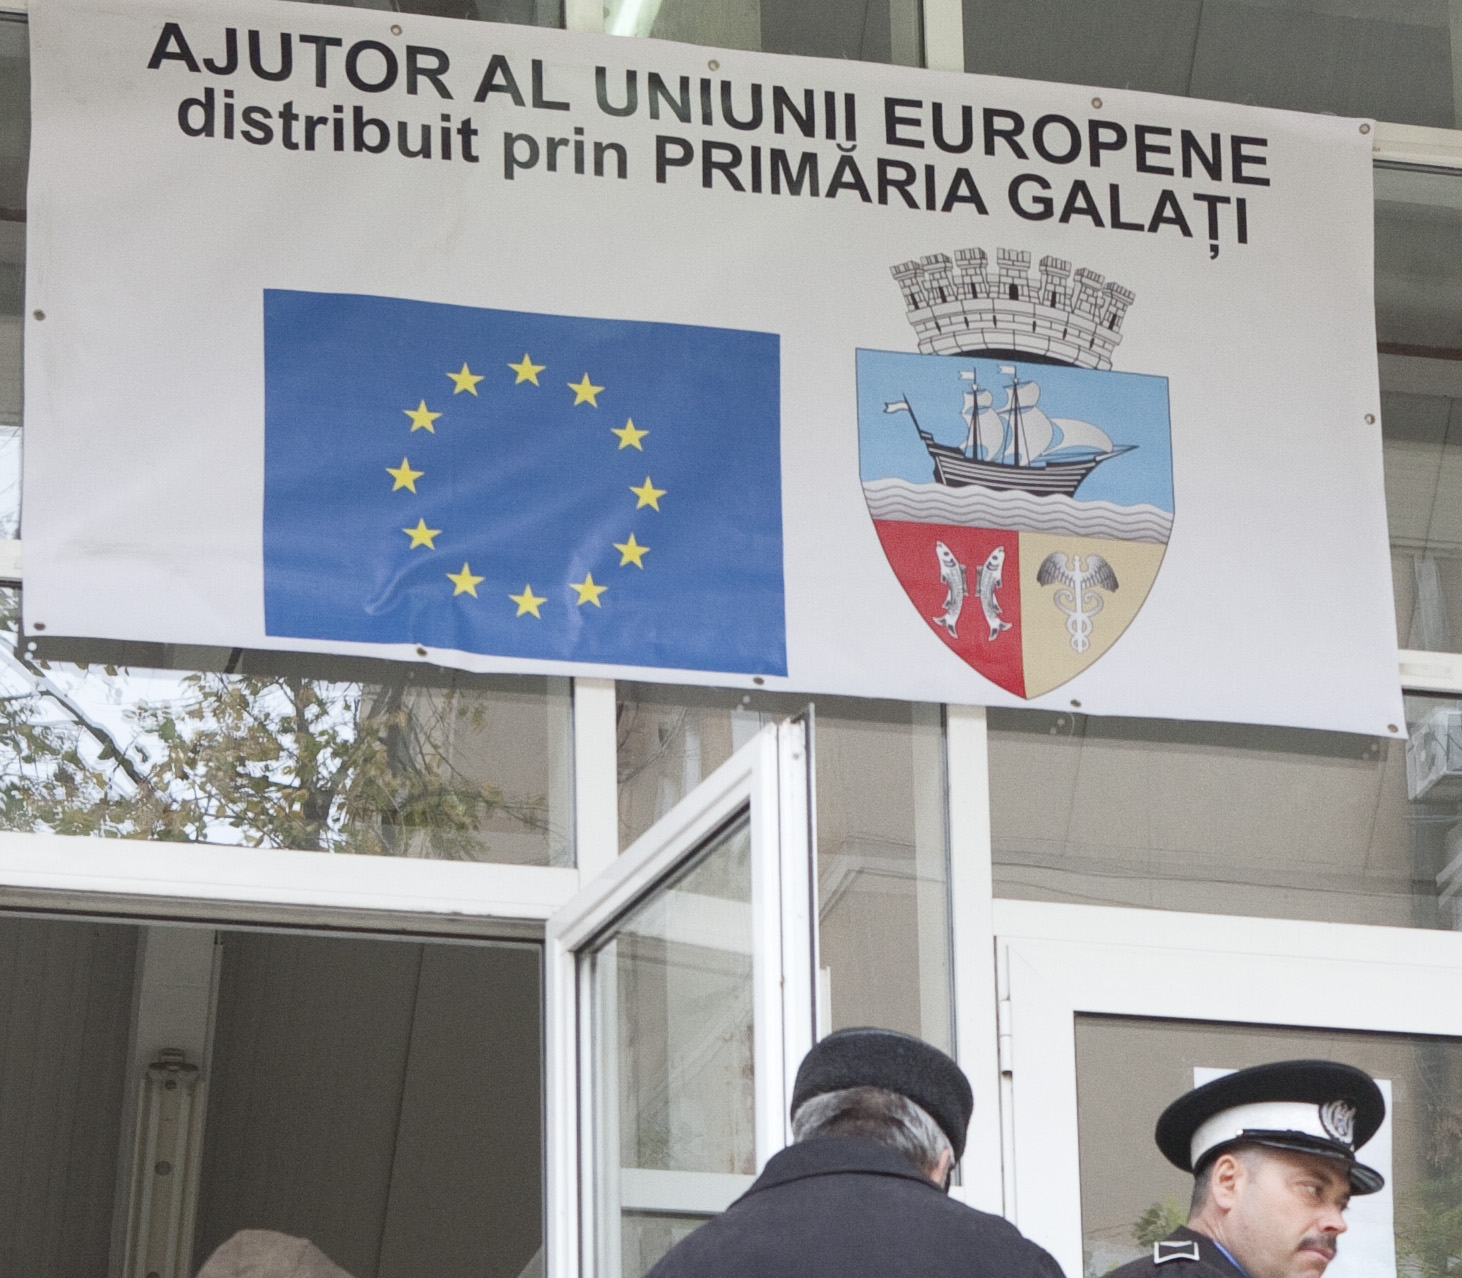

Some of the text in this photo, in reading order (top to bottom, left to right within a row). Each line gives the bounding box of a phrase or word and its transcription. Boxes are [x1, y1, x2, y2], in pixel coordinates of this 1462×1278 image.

[147, 22, 1271, 187] AJUTOR AL UNIUNII EUROPENE
[177, 86, 1248, 261] distribuit prin PRIMĂRIA GALAȚI
